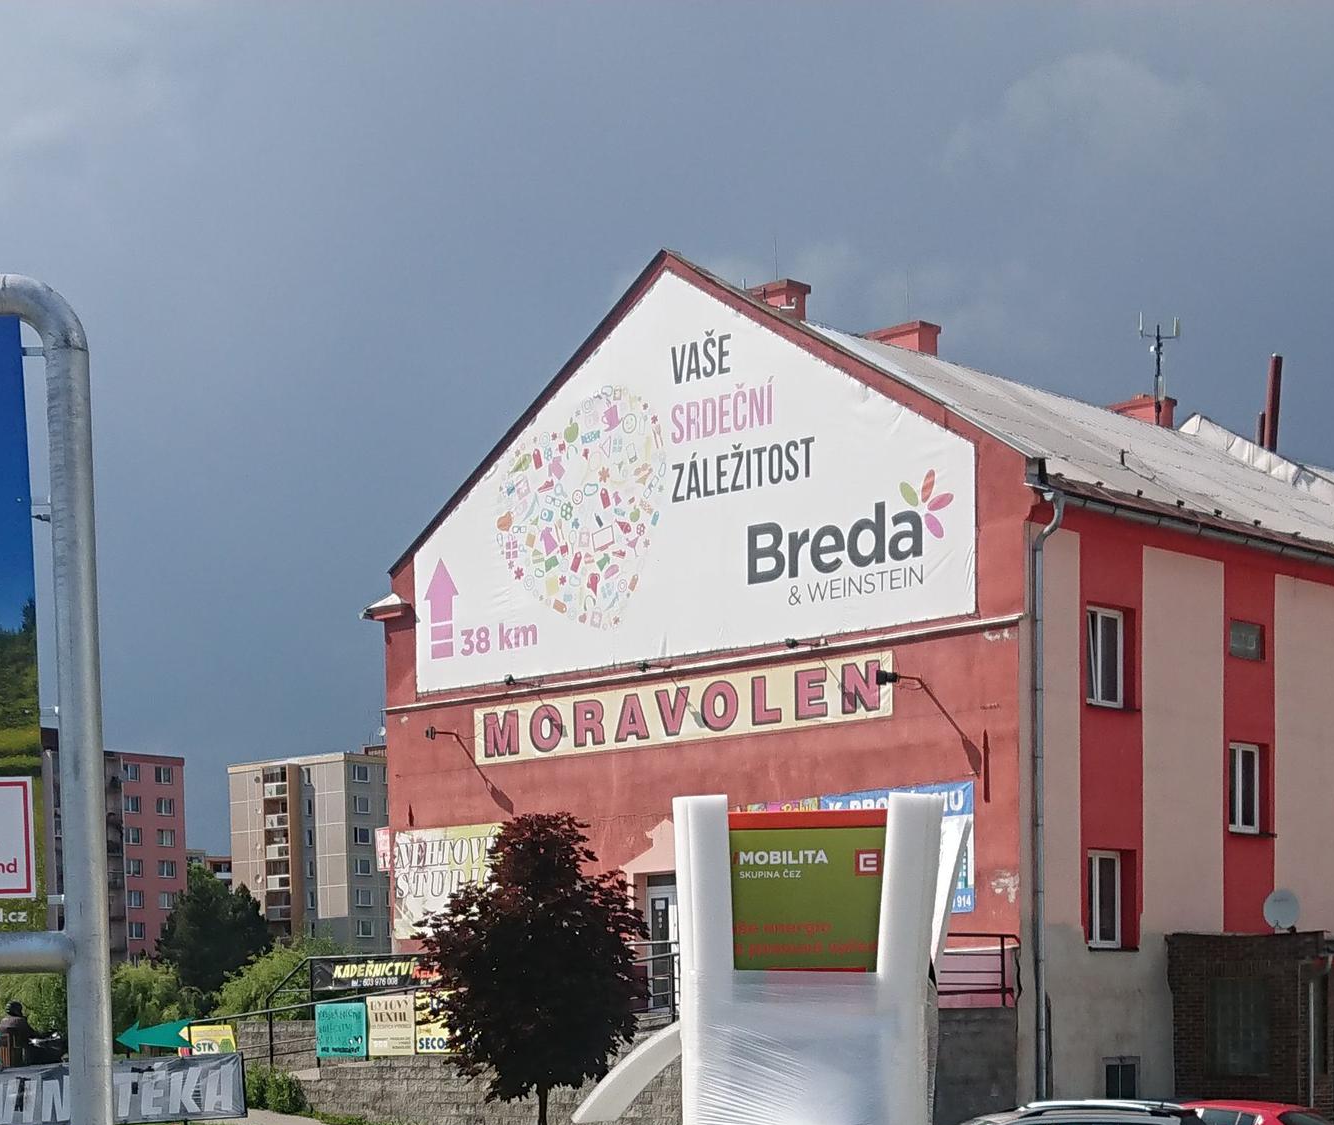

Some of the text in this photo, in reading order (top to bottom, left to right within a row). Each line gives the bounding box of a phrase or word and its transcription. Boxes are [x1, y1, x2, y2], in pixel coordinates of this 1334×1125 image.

[671, 332, 732, 385] VAŠE
[671, 376, 775, 446] SRDEČNÍ
[671, 436, 816, 504] ZÁLEŽITOST
[747, 501, 923, 586] Breda
[788, 563, 924, 606] & WEINSTEIN
[461, 623, 539, 657] 38 km
[483, 660, 882, 758] MORAVOLEN
[739, 868, 802, 879] SKUPINA ČEZ
[333, 957, 417, 979] KADEŘNICTVÍ
[195, 1042, 214, 1052] STK
